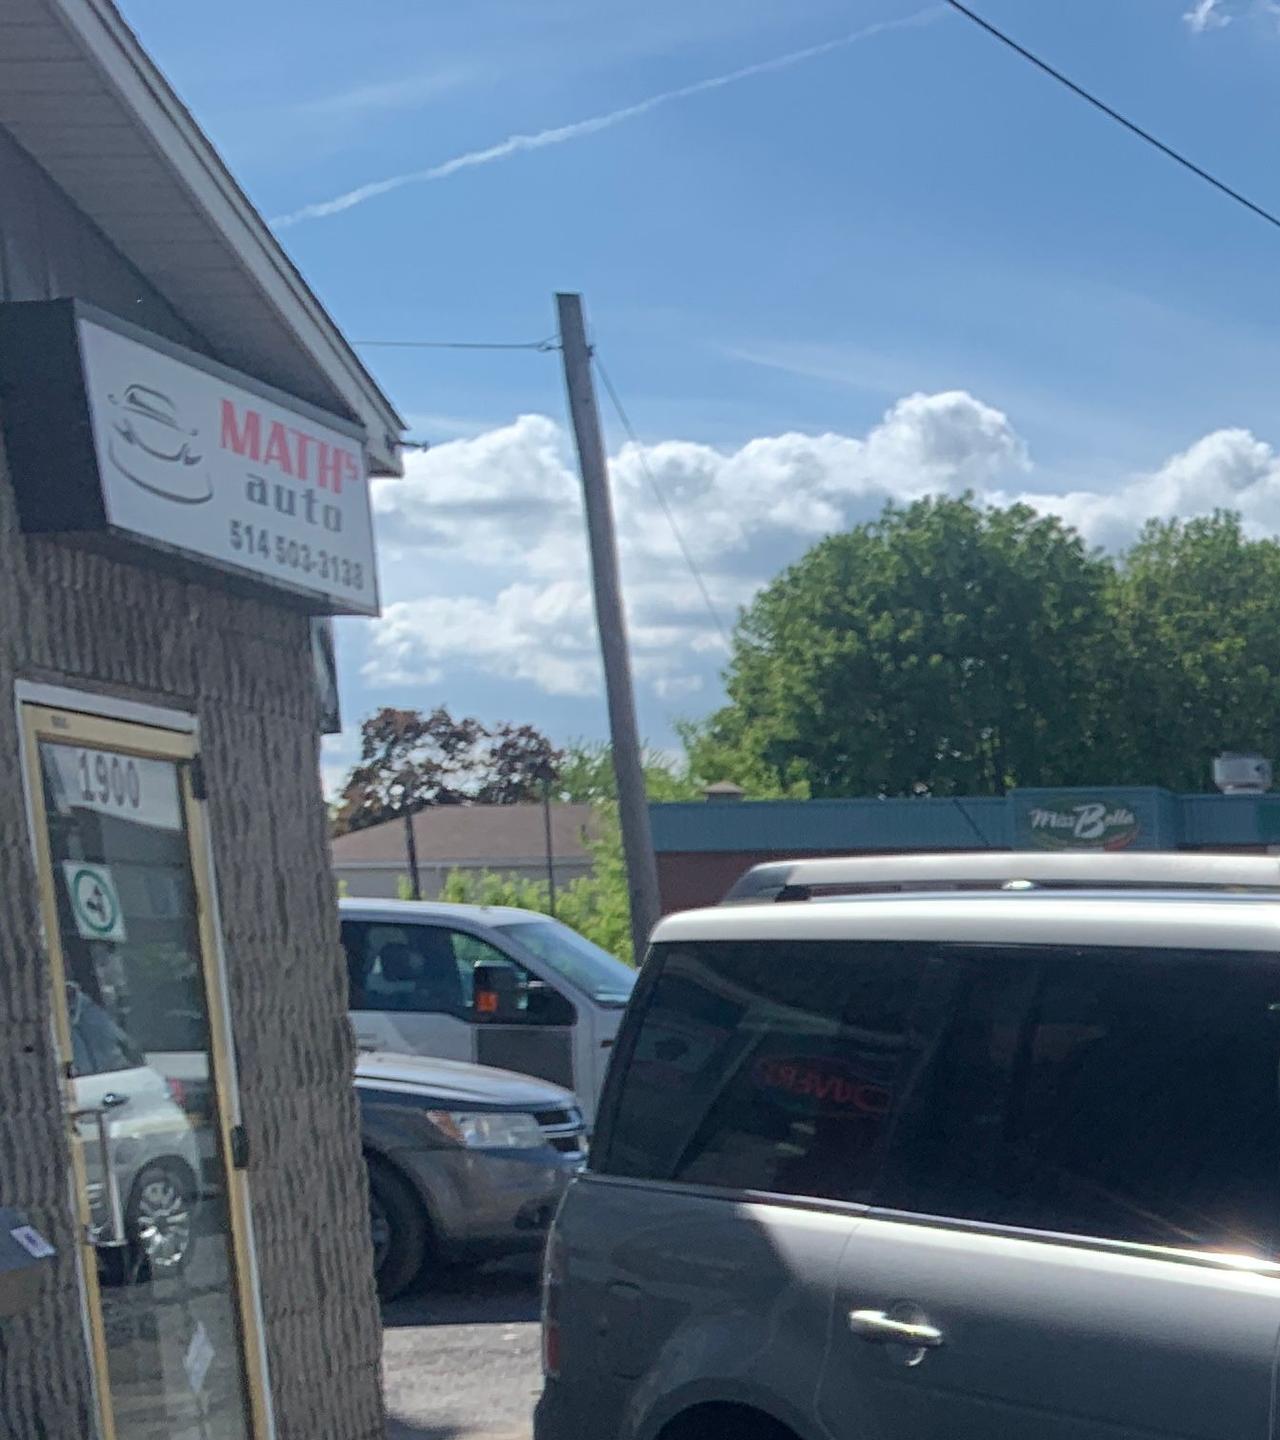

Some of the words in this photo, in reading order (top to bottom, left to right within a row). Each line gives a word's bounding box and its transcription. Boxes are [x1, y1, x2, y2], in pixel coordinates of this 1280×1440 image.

[245, 472, 343, 532] auto
[229, 519, 271, 559] 514
[80, 751, 140, 809] 1900
